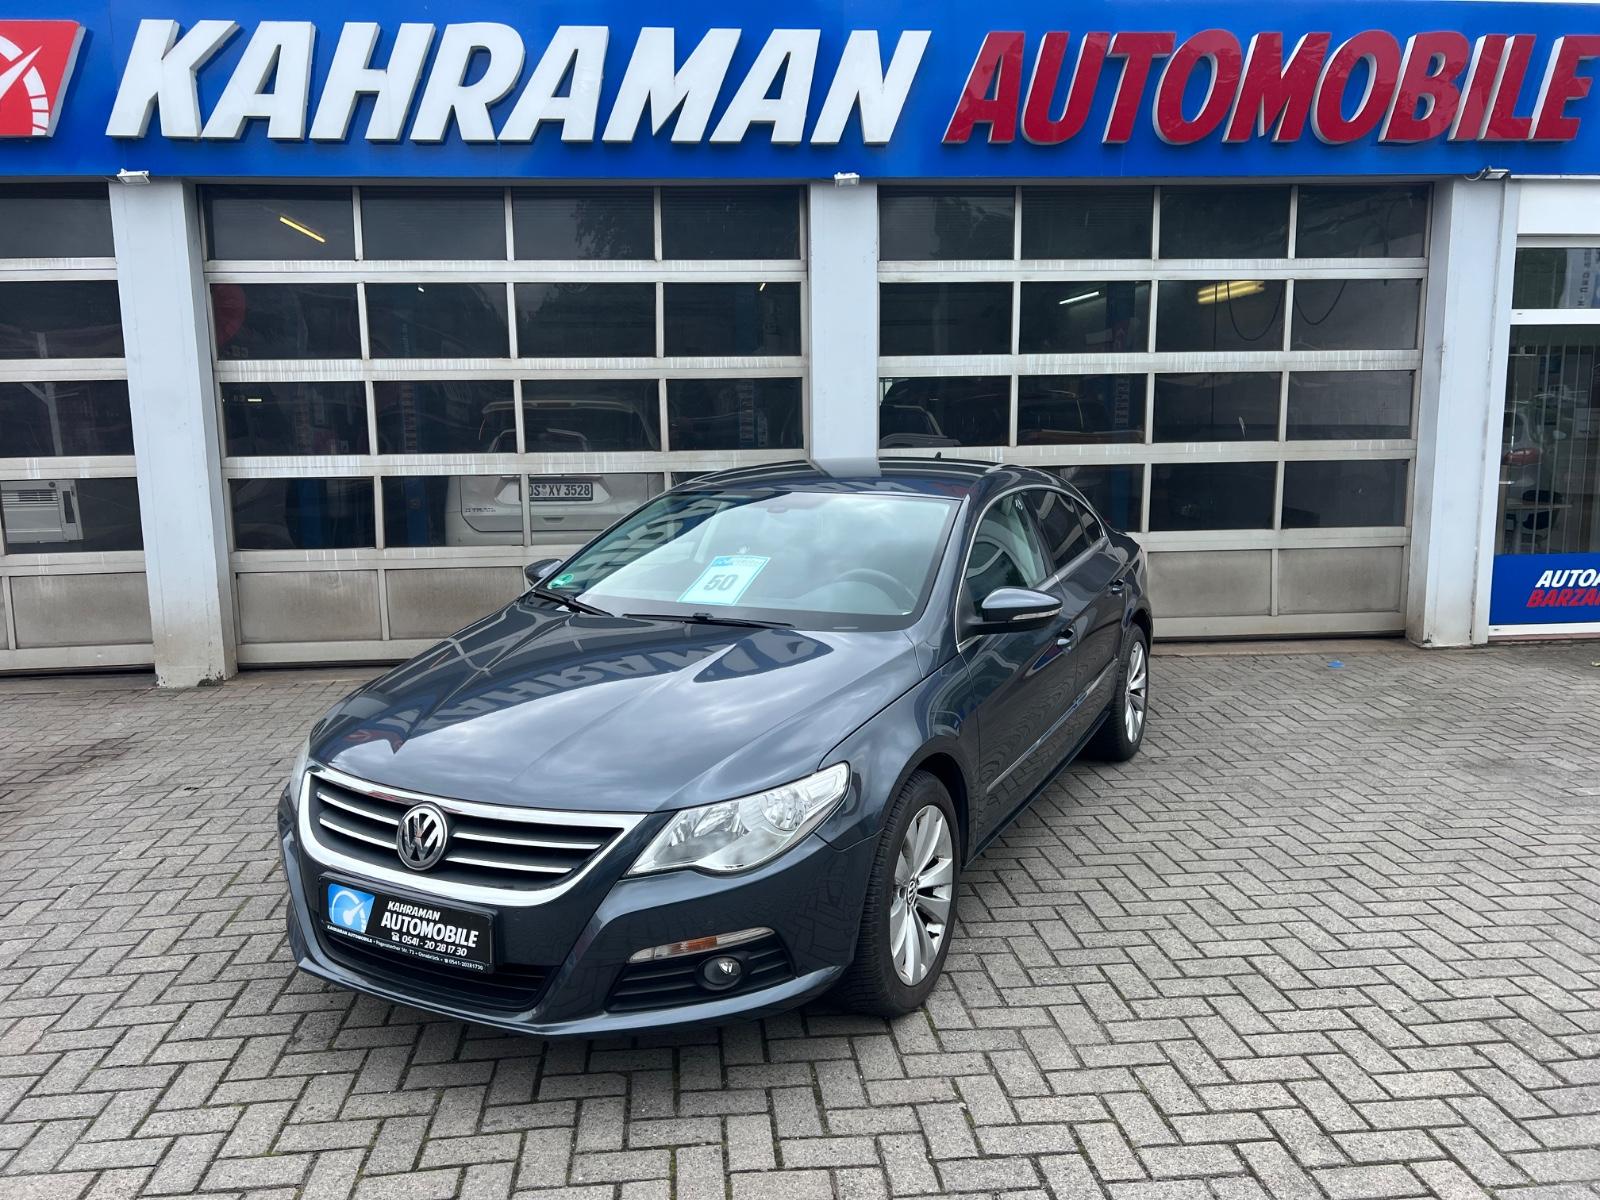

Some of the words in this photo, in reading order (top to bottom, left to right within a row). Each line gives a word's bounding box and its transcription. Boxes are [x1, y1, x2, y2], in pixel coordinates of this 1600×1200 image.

[105, 19, 931, 144] KAHRAMAN
[942, 29, 1598, 146] AUTOMOBILE
[548, 485, 562, 497] XY
[564, 484, 591, 497] 3528
[704, 574, 739, 591] 50
[400, 805, 447, 868] VW
[387, 901, 441, 921] KAHRAMAN
[381, 912, 479, 948] AUTOMOBILE
[402, 935, 419, 947] 0541
[425, 940, 436, 950] 20
[436, 942, 446, 952] 28
[447, 944, 455, 954] 17
[456, 946, 468, 957] 30
